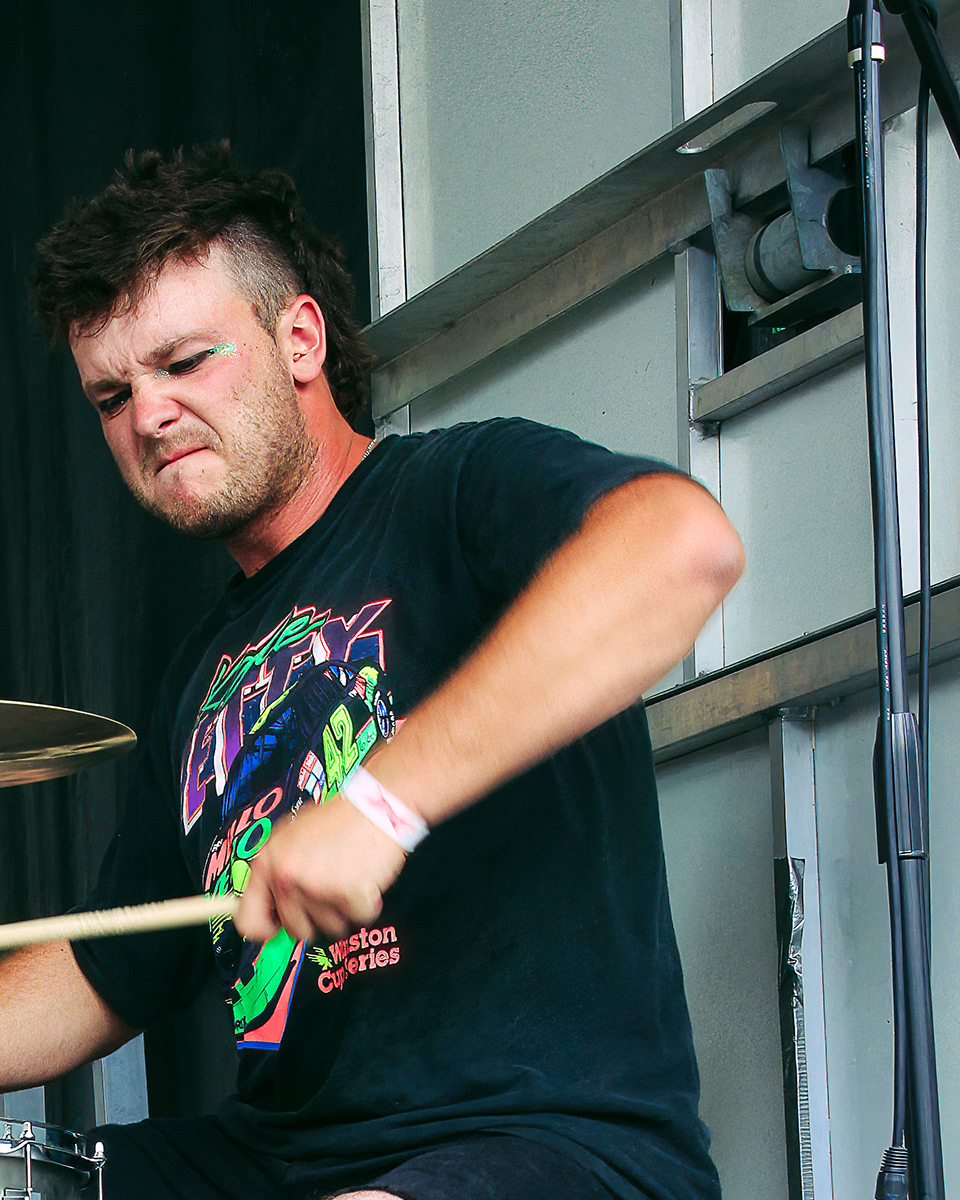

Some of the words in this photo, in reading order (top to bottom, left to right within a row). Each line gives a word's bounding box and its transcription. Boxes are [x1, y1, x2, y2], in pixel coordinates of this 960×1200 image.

[182, 598, 393, 837] ETTY
[322, 704, 360, 791] 42
[345, 946, 401, 975] eries
